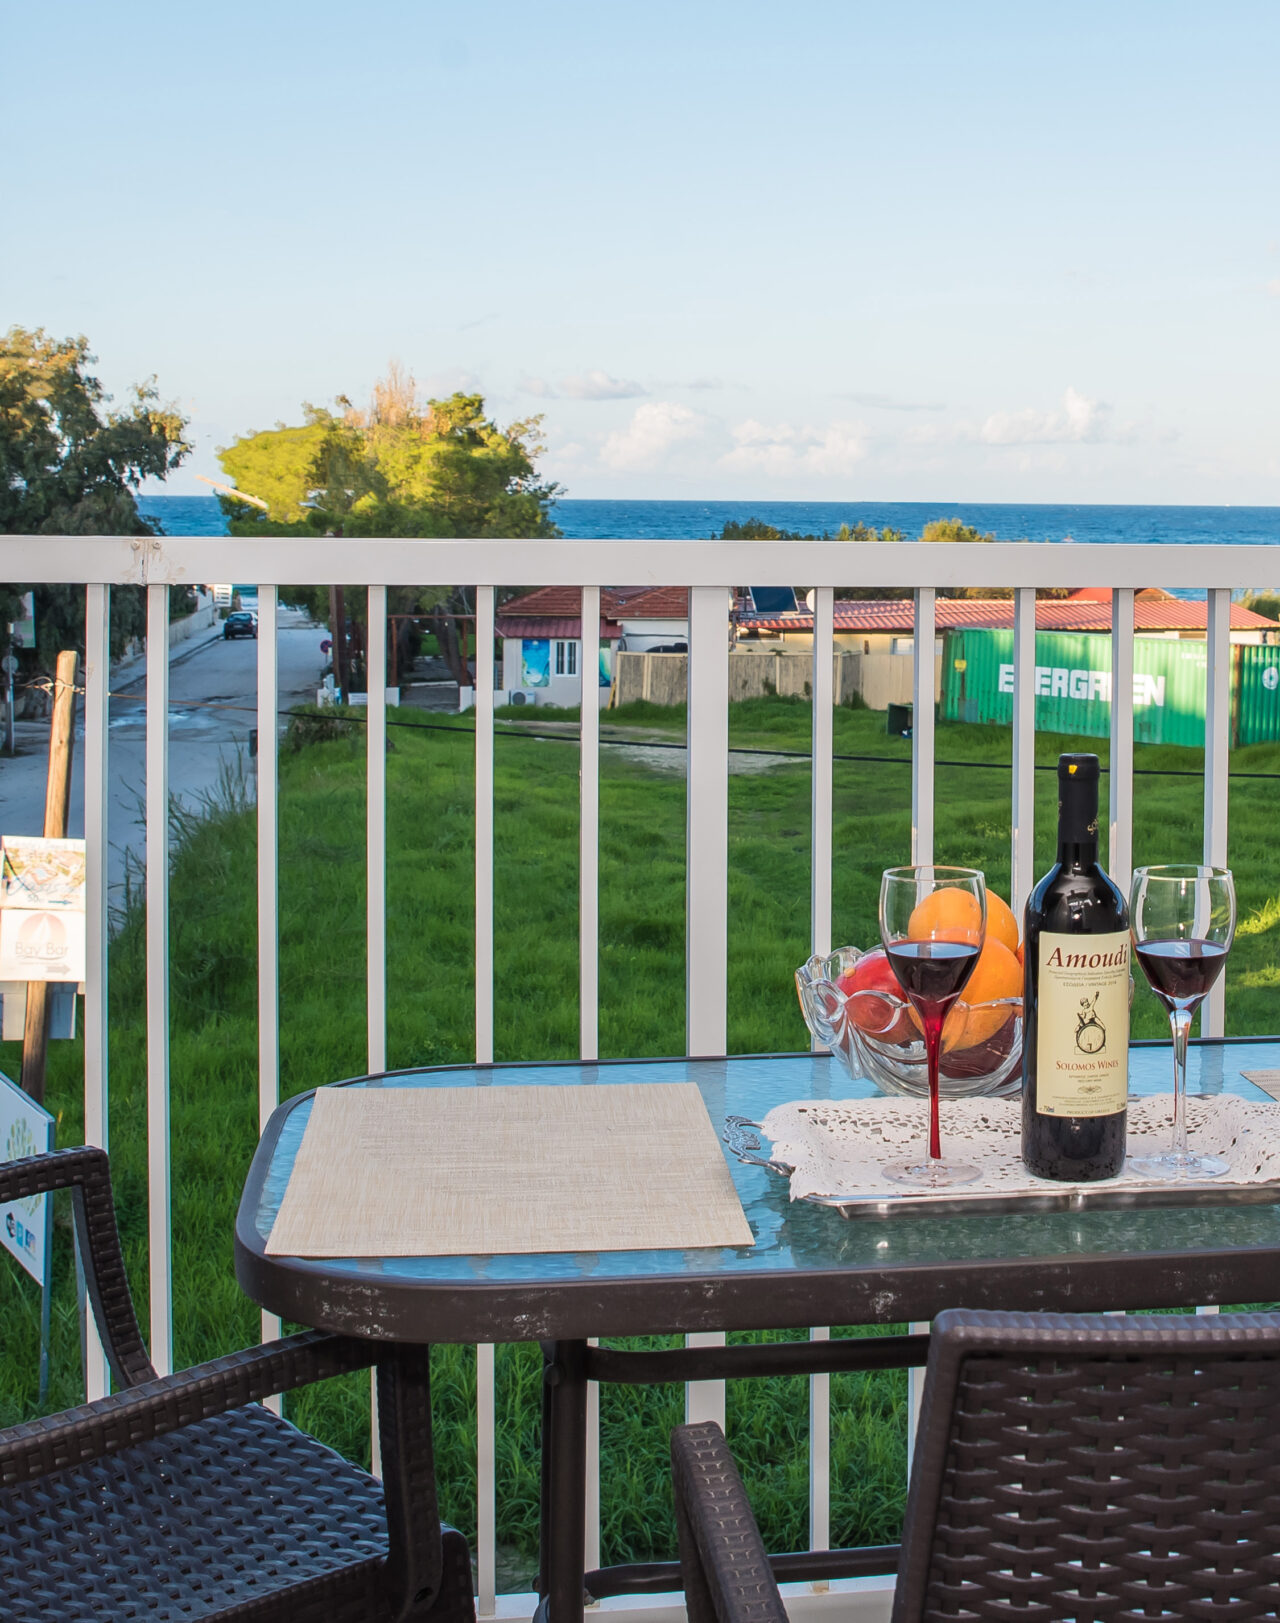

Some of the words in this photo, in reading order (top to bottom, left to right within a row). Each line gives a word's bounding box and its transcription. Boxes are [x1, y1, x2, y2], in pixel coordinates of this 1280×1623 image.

[998, 663, 1166, 707] EERGREN
[15, 941, 41, 956] Bay
[47, 942, 69, 955] Bar
[1046, 943, 1128, 968] Amoudi
[1056, 1060, 1096, 1071] SOLOMOS
[1097, 1059, 1119, 1069] WINES
